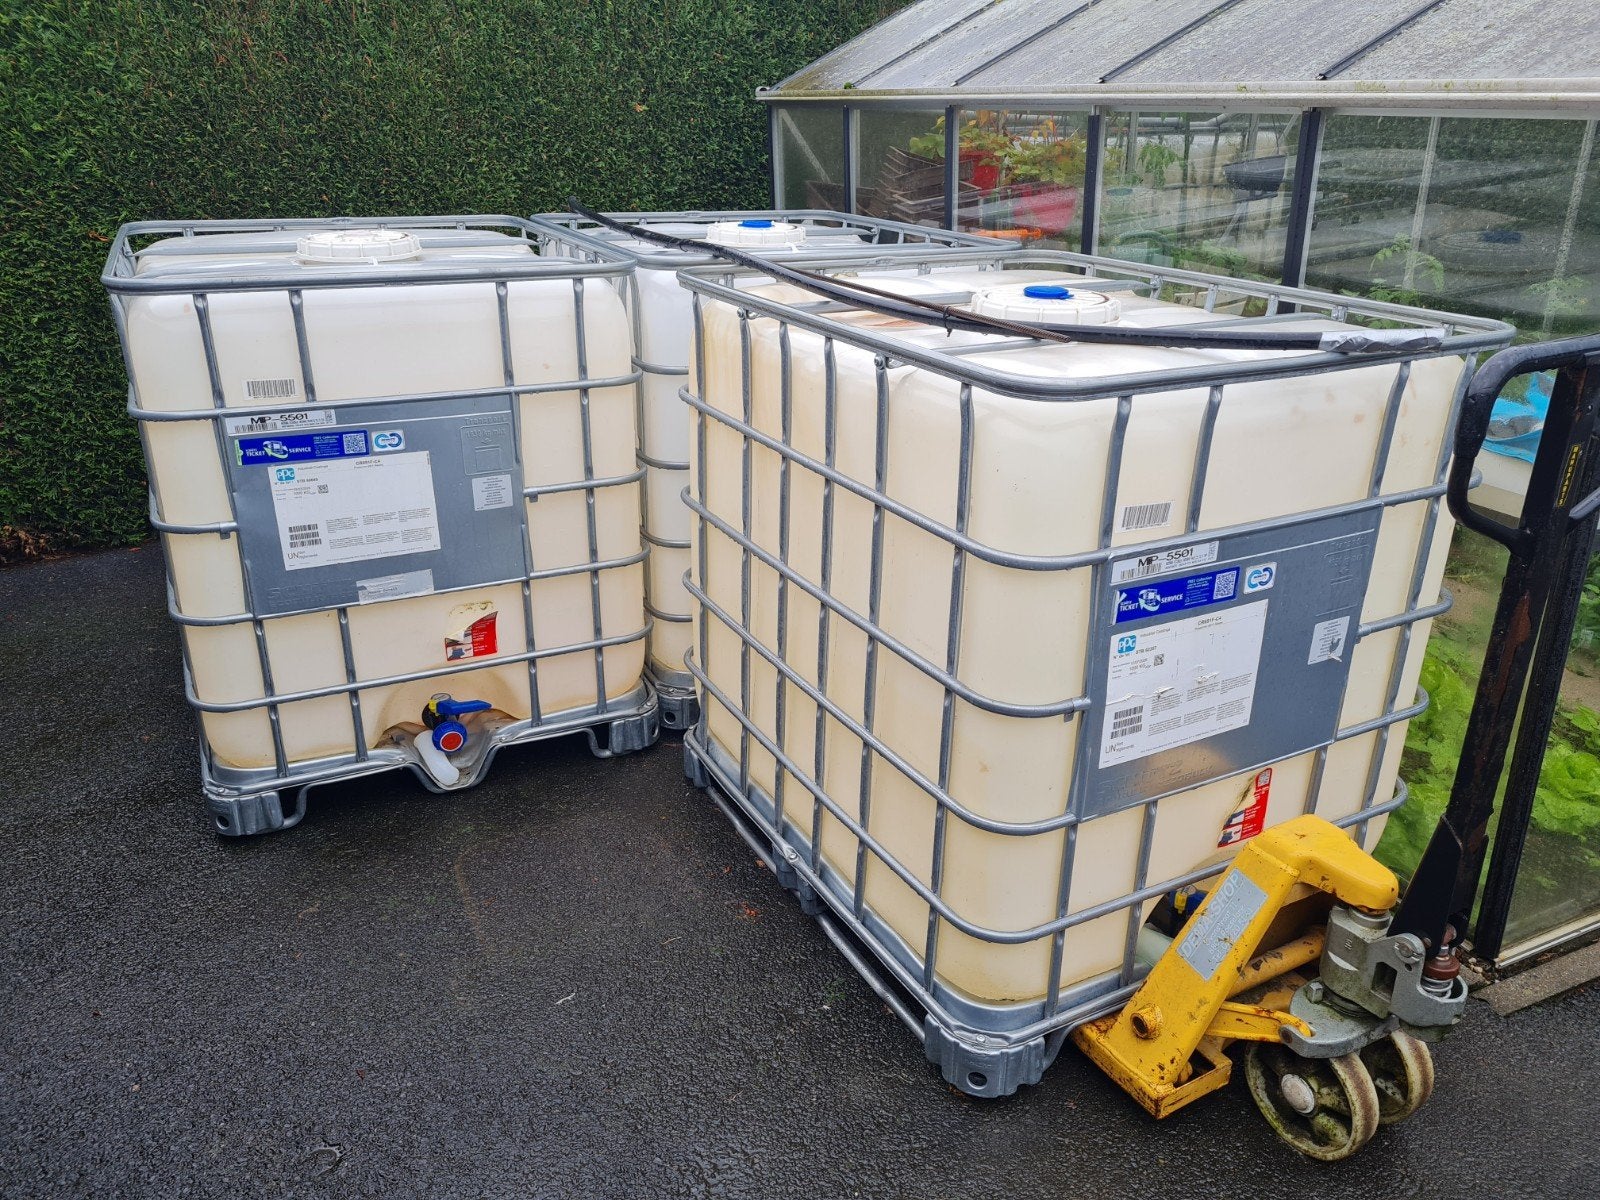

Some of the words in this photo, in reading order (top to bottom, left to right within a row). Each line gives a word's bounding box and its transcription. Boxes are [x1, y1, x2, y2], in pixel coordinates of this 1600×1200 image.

[289, 446, 312, 454] SERVICE
[277, 468, 295, 480] PPG
[1120, 602, 1139, 612] TICKET
[1161, 593, 1184, 604] SERVICE
[1119, 636, 1136, 652] PPG
